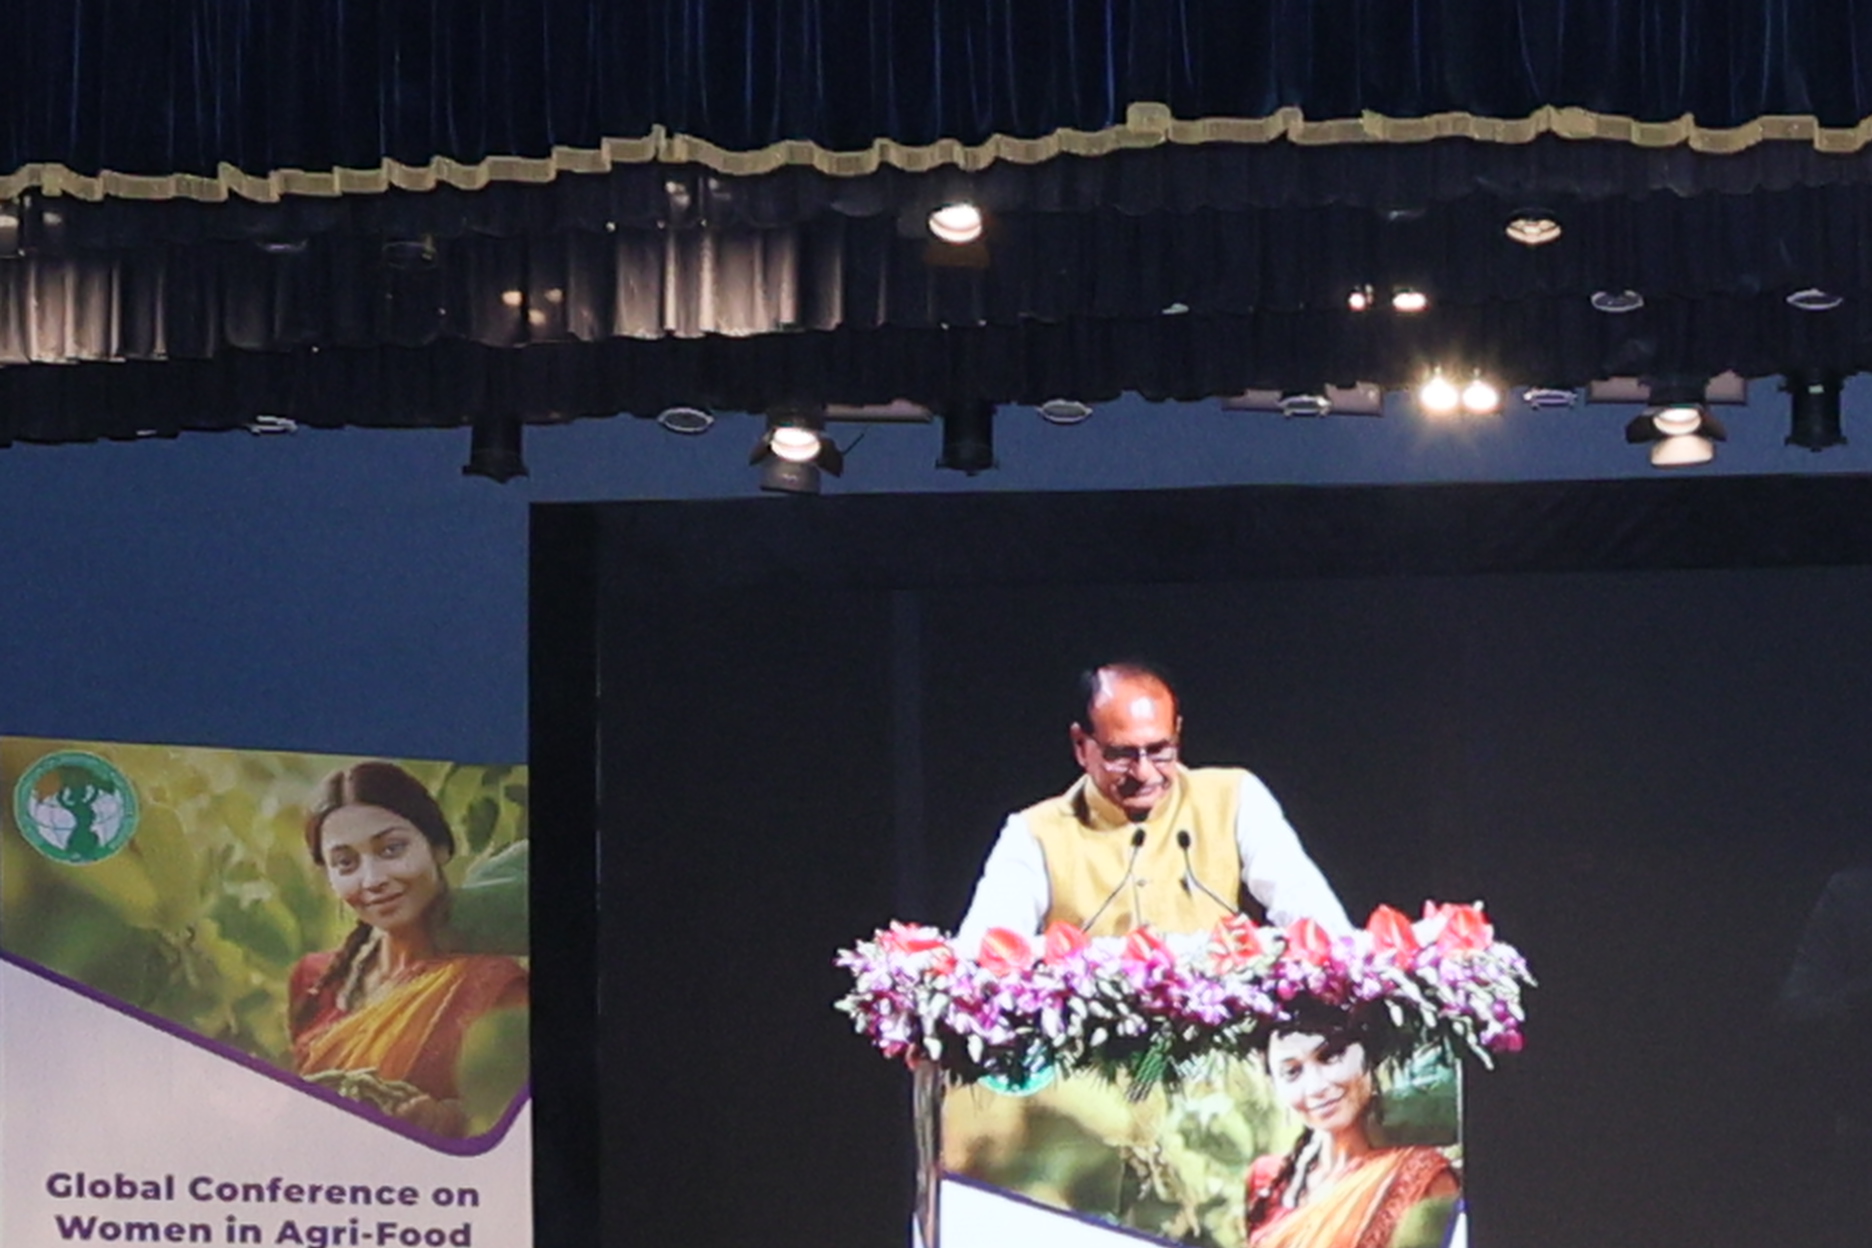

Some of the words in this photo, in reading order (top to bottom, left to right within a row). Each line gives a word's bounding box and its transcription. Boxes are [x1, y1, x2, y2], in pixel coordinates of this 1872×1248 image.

[46, 1173, 174, 1200] Global
[189, 1176, 419, 1206] Conference
[432, 1188, 479, 1207] on
[55, 1215, 212, 1243] Women
[226, 1215, 261, 1244] in
